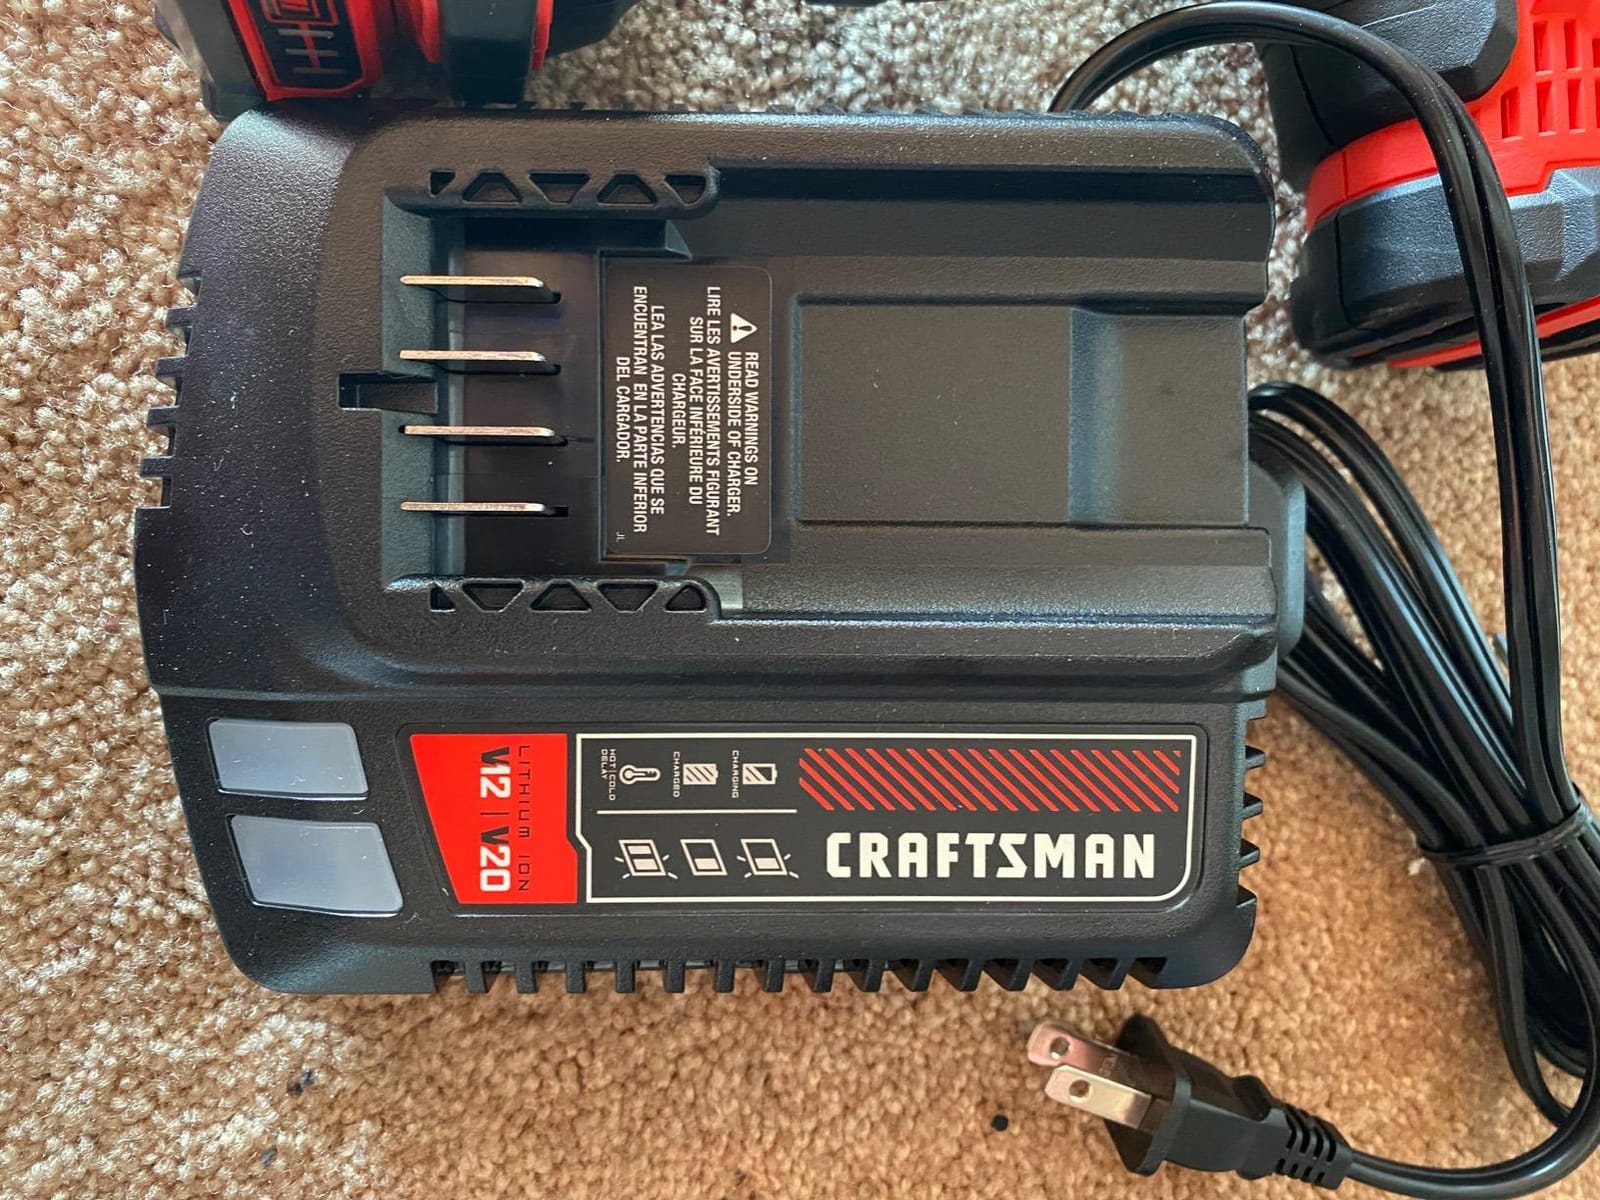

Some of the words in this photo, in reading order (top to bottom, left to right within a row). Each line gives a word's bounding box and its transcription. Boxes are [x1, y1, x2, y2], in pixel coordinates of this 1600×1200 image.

[651, 306, 664, 330] LEA
[707, 286, 720, 316] LIRE
[634, 286, 648, 375] ENCUENTRAN
[651, 335, 664, 360] LAS
[690, 316, 704, 343] SUR
[707, 320, 720, 344] LES
[616, 356, 630, 382] DEL
[690, 348, 704, 365] LA
[744, 352, 759, 388] READ
[634, 383, 648, 400] EN
[690, 369, 704, 402] FACE
[728, 352, 742, 426] UNDERSIDE
[616, 386, 630, 462] CARGADOR.
[634, 405, 648, 422] LA
[650, 365, 664, 464] ADVERTENCIAS
[672, 373, 686, 448] CHARGEUR.
[706, 348, 720, 466] AVERTISSEMENTS
[689, 406, 706, 482] INFÉRIEURE
[728, 431, 742, 448] OF
[744, 391, 759, 463] WARNINGS
[633, 426, 648, 468] PARTE
[650, 468, 664, 494] QUE
[727, 451, 741, 516] CHARGER.
[744, 467, 758, 486] ON
[633, 472, 648, 532] INFERIOR
[650, 498, 664, 514] SE
[689, 486, 702, 505] DU
[706, 470, 720, 536] FIGURANT
[480, 746, 511, 798] V12
[600, 748, 608, 780] DELAY
[609, 748, 617, 768] HOT
[672, 751, 680, 798] CHARGED
[732, 750, 740, 798] CHARGING
[518, 745, 531, 838] LITHIUM
[608, 774, 616, 801] COLD
[480, 826, 511, 892] V20
[518, 855, 530, 891] ION
[826, 832, 1155, 880] CRAFTSMAN
